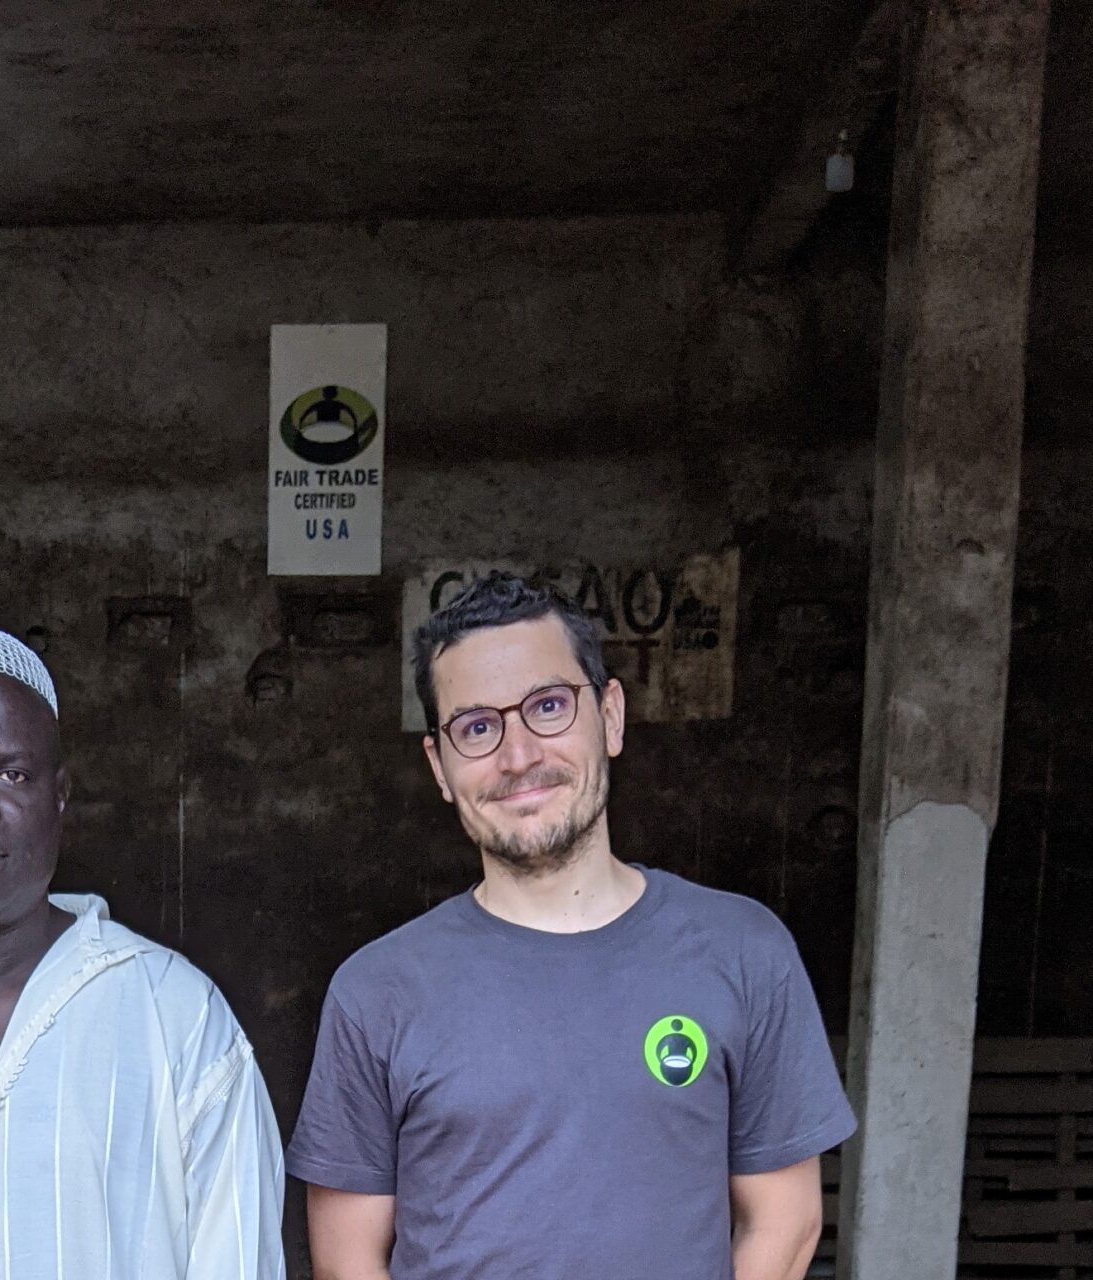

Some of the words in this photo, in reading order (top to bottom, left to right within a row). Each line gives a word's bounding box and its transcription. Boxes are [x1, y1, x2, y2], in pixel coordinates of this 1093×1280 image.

[274, 469, 309, 488] FAIR
[315, 468, 379, 487] TRADE
[294, 492, 356, 510] CERTIFIED
